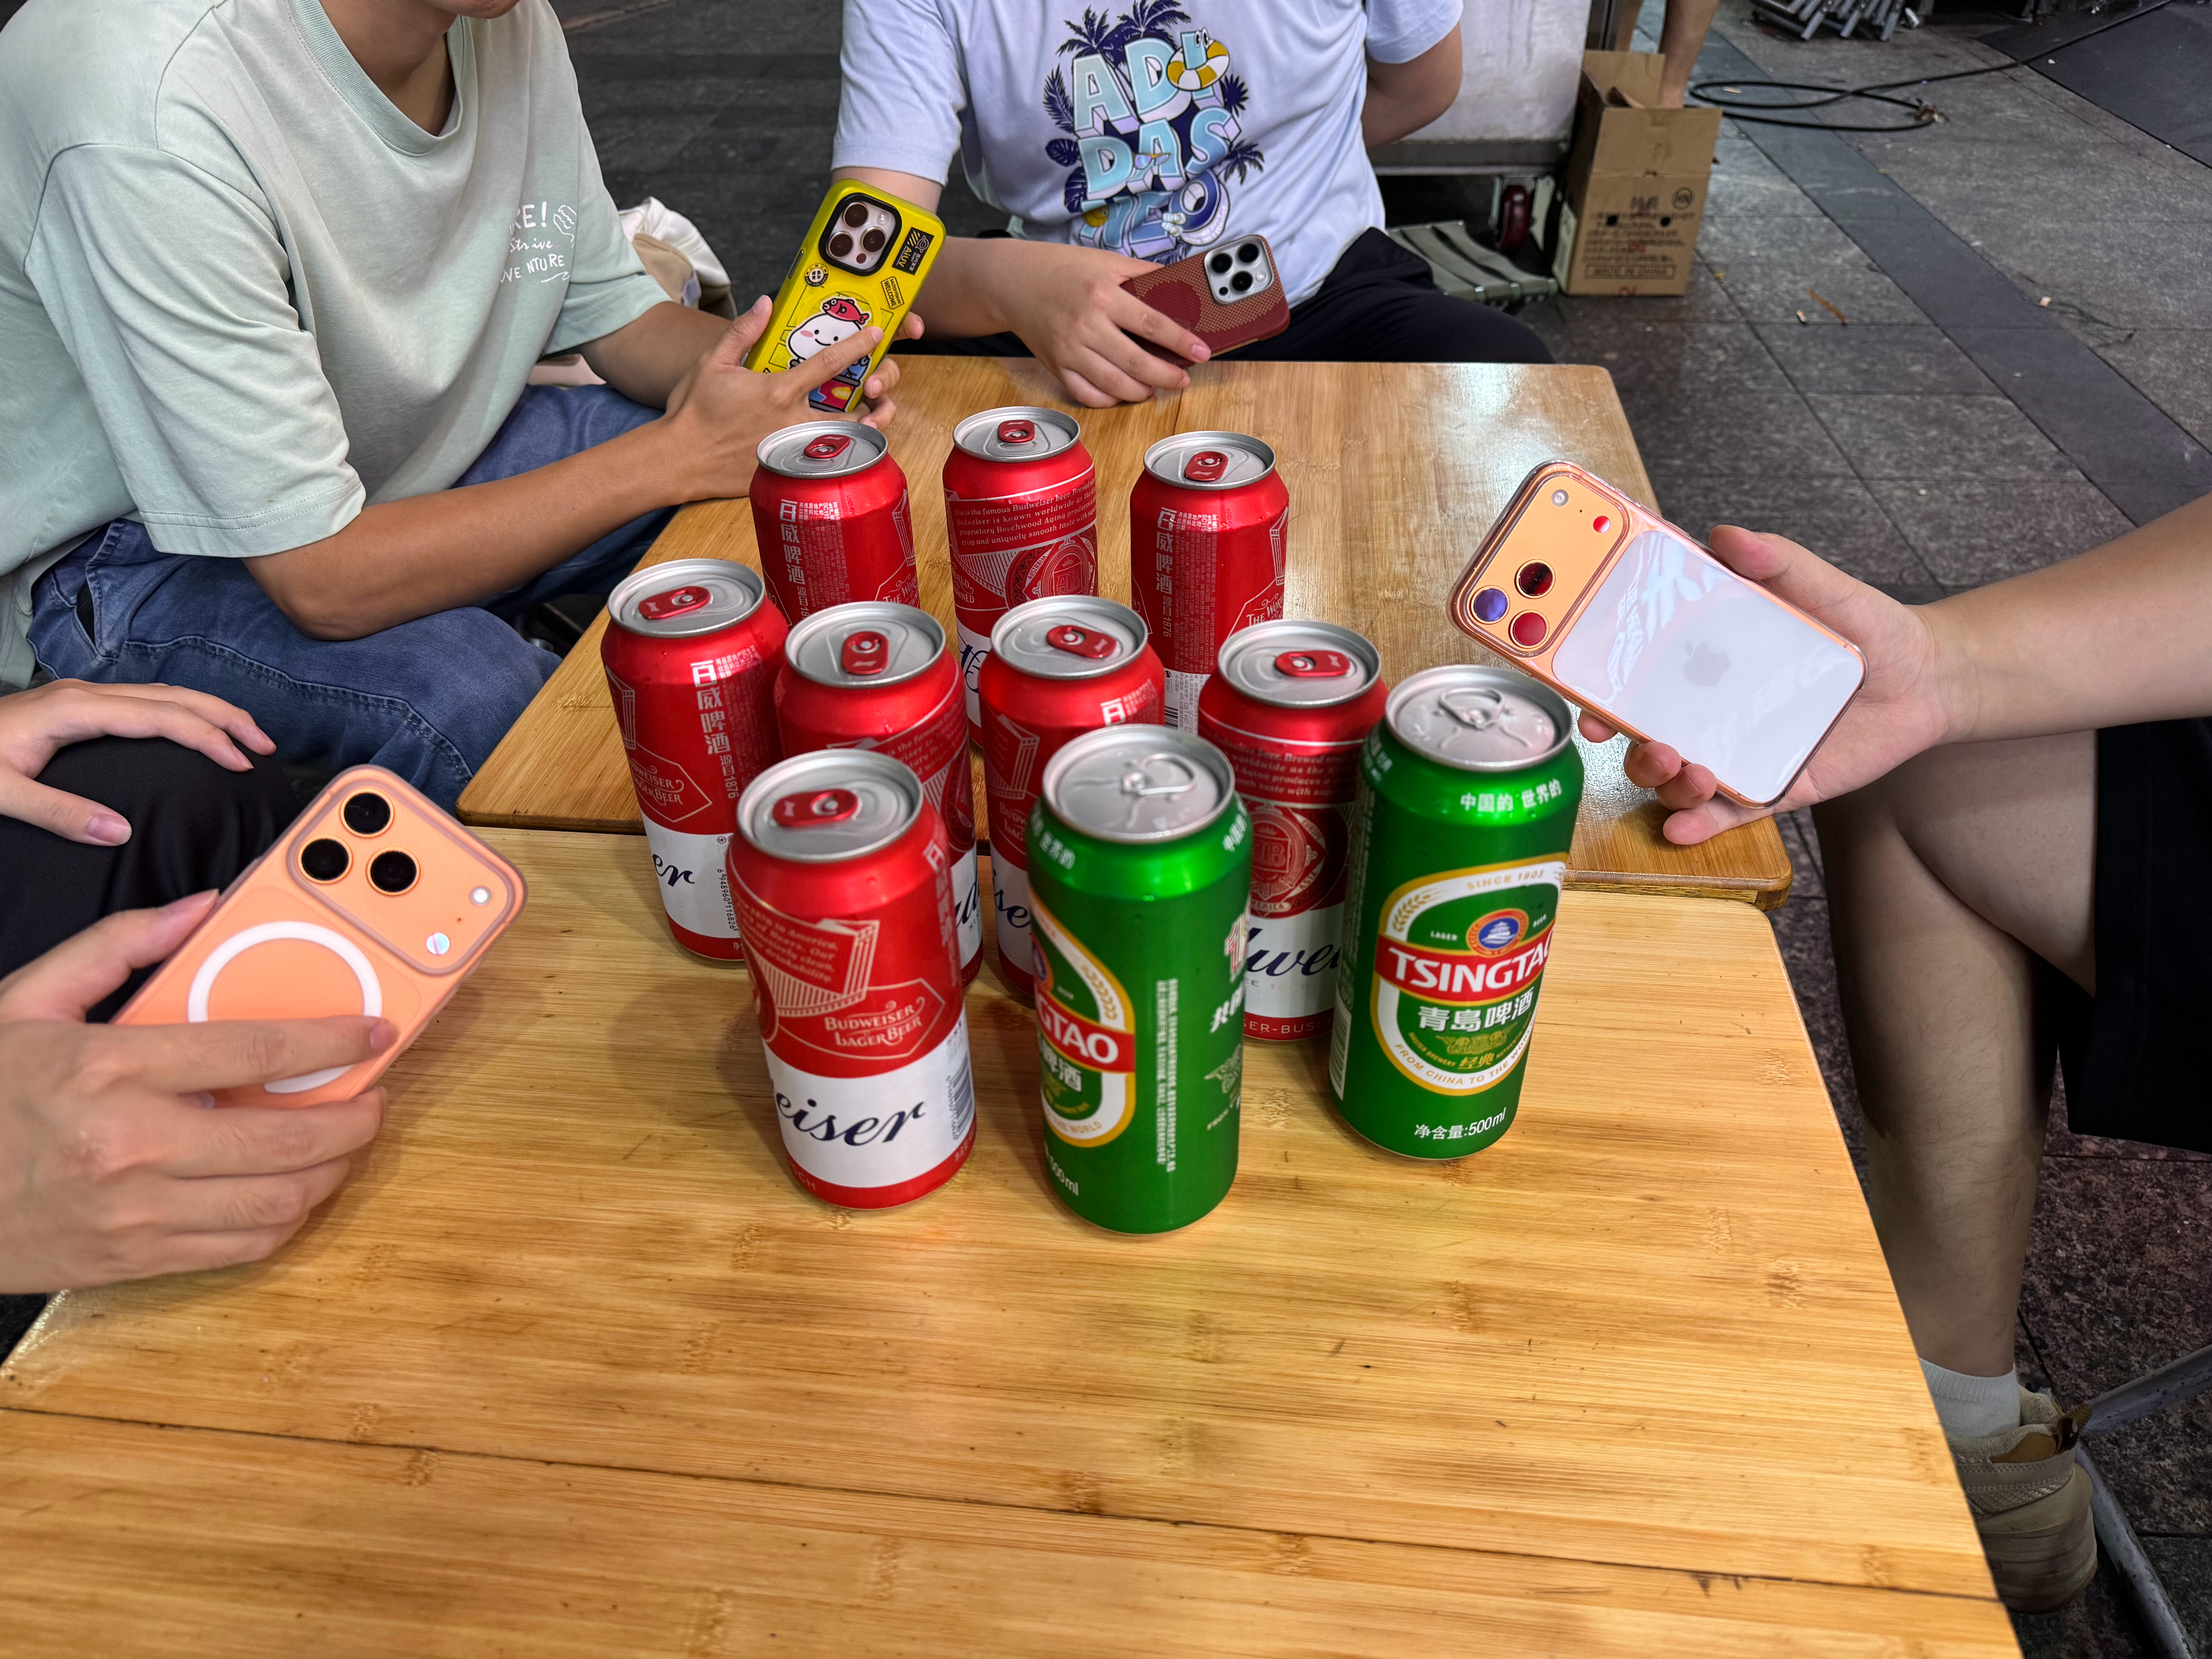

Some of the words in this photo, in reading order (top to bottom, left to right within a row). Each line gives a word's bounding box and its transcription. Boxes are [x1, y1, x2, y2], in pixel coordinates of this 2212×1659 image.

[1078, 107, 1241, 199] DAS
[884, 280, 896, 307] WELCOME
[982, 508, 1011, 516] famous
[1013, 498, 1054, 512] Budweiser
[1003, 513, 1031, 523] known
[1035, 500, 1075, 517] worldwide
[991, 533, 1026, 543] uniquely
[1029, 525, 1057, 538] smooth
[1059, 519, 1075, 529] taste
[997, 519, 1042, 533] Beechwood
[1044, 514, 1065, 524] Aging
[780, 499, 805, 585] 百威啤酒
[1156, 507, 1177, 595] 百威啤酒
[1027, 555, 1047, 580] AUSTRALIA
[1247, 613, 1265, 626] THE
[690, 659, 731, 755] 百威啤酒
[654, 788, 684, 805] BEER
[1460, 792, 1514, 812] 中国的
[1521, 778, 1562, 808] 世界的
[1467, 874, 1512, 890] SINCE
[1533, 913, 1547, 928] BEER
[1430, 930, 1458, 941] LAGER
[824, 1004, 915, 1031] BUDWEISER
[834, 1031, 886, 1047] LAGER
[886, 1016, 922, 1041] BEER
[1395, 1043, 1424, 1071] FROM
[1426, 1070, 1463, 1085] CHINA
[1470, 1075, 1485, 1084] TO
[1489, 1061, 1509, 1078] THE
[1457, 1052, 1494, 1070] 经典
